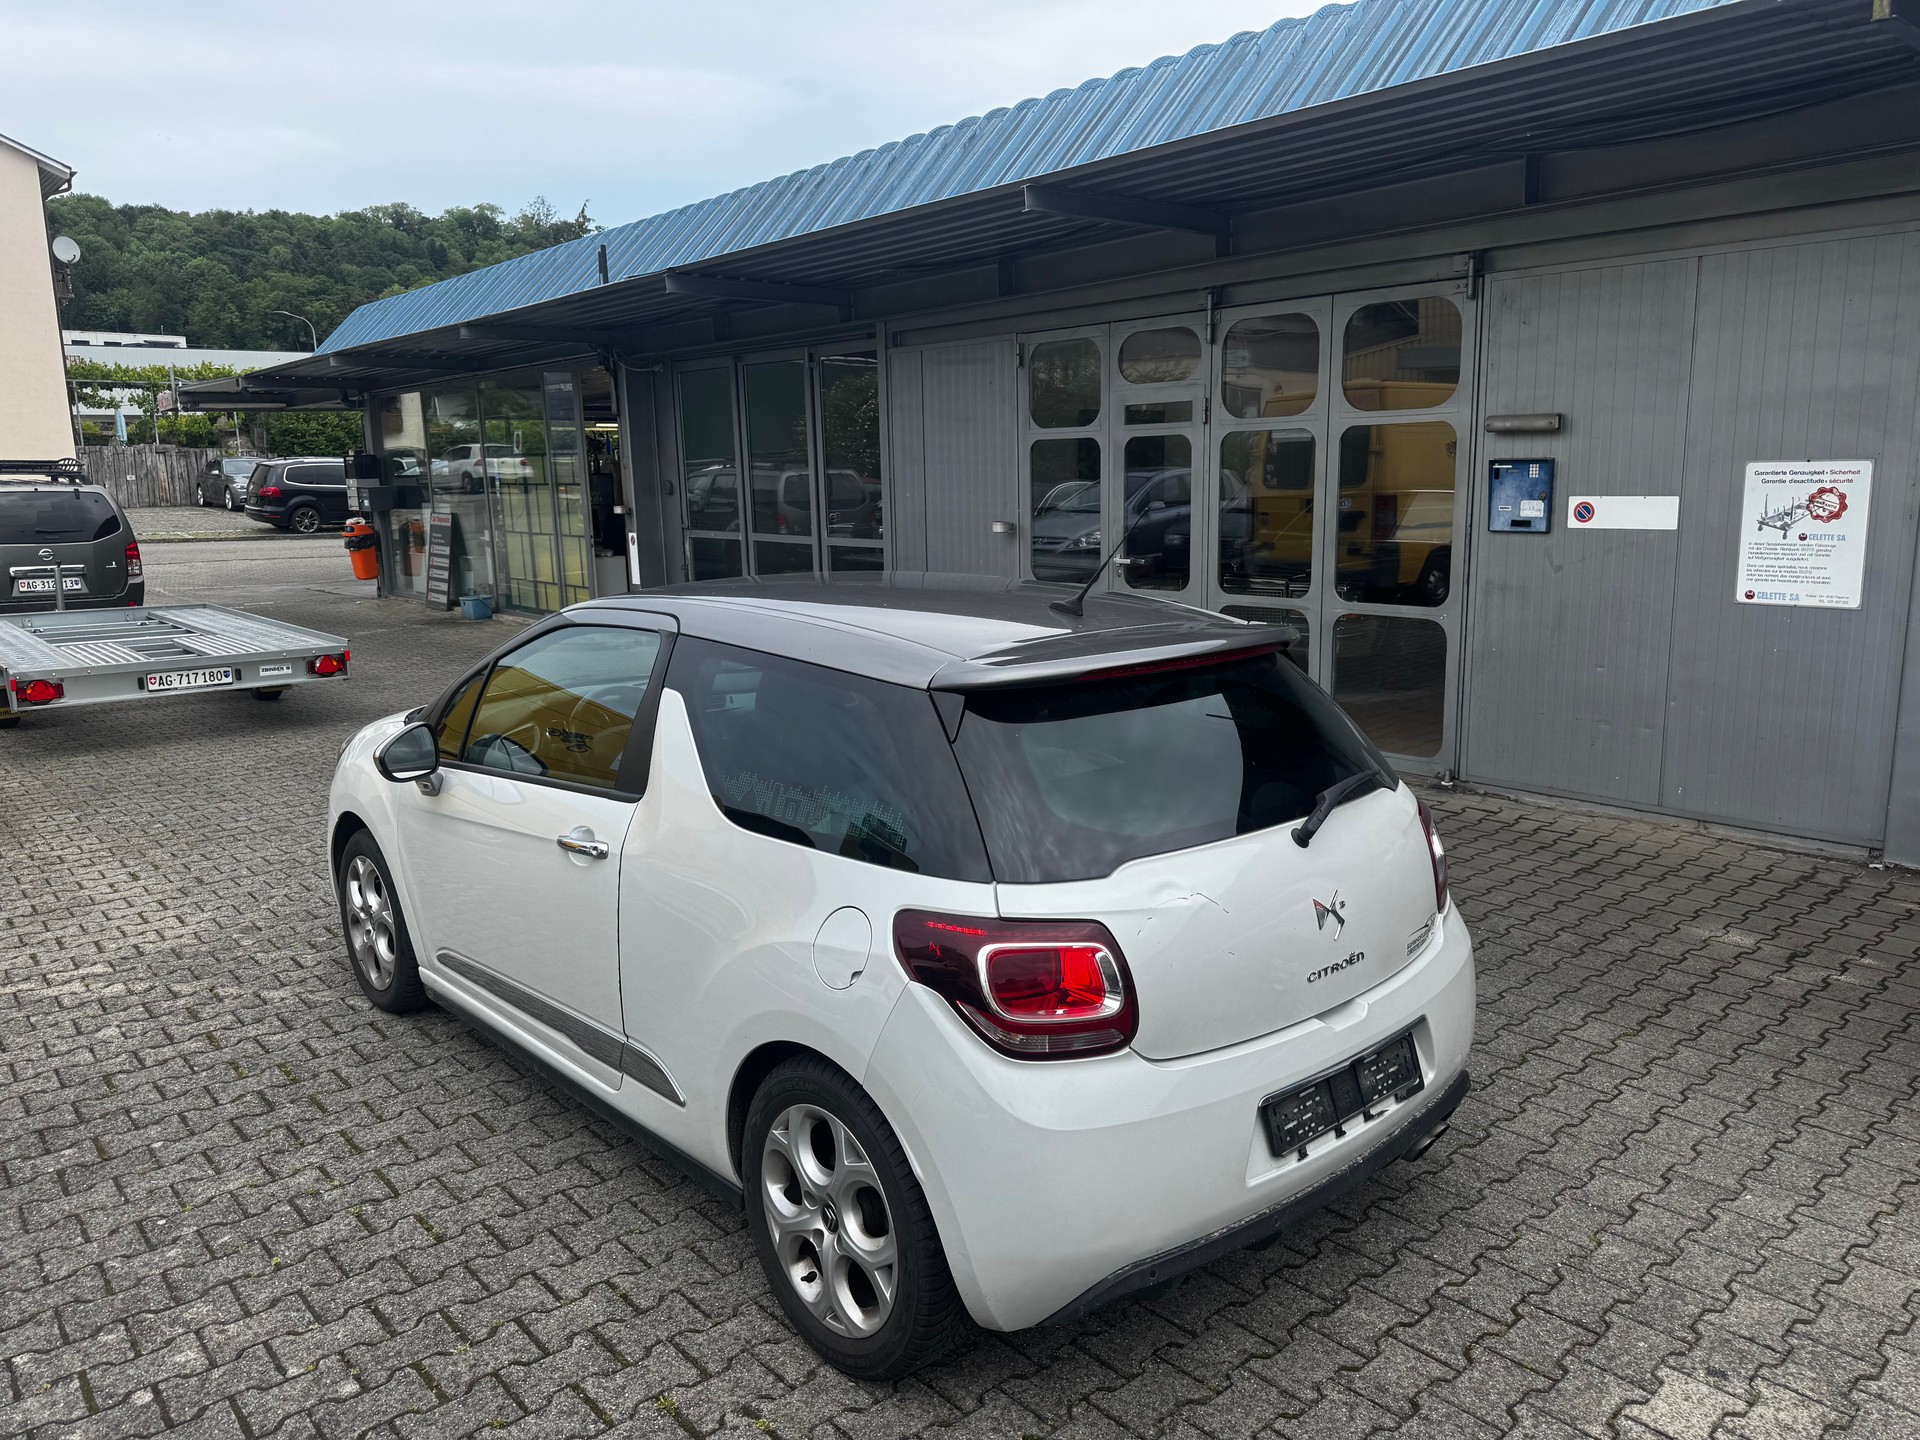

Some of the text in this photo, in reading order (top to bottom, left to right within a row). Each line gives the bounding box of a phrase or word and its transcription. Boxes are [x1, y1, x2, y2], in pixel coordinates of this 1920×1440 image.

[1809, 533, 1834, 541] CELETTE
[1757, 591, 1799, 601] CELETTE SA
[1307, 951, 1365, 983] CITROËN
